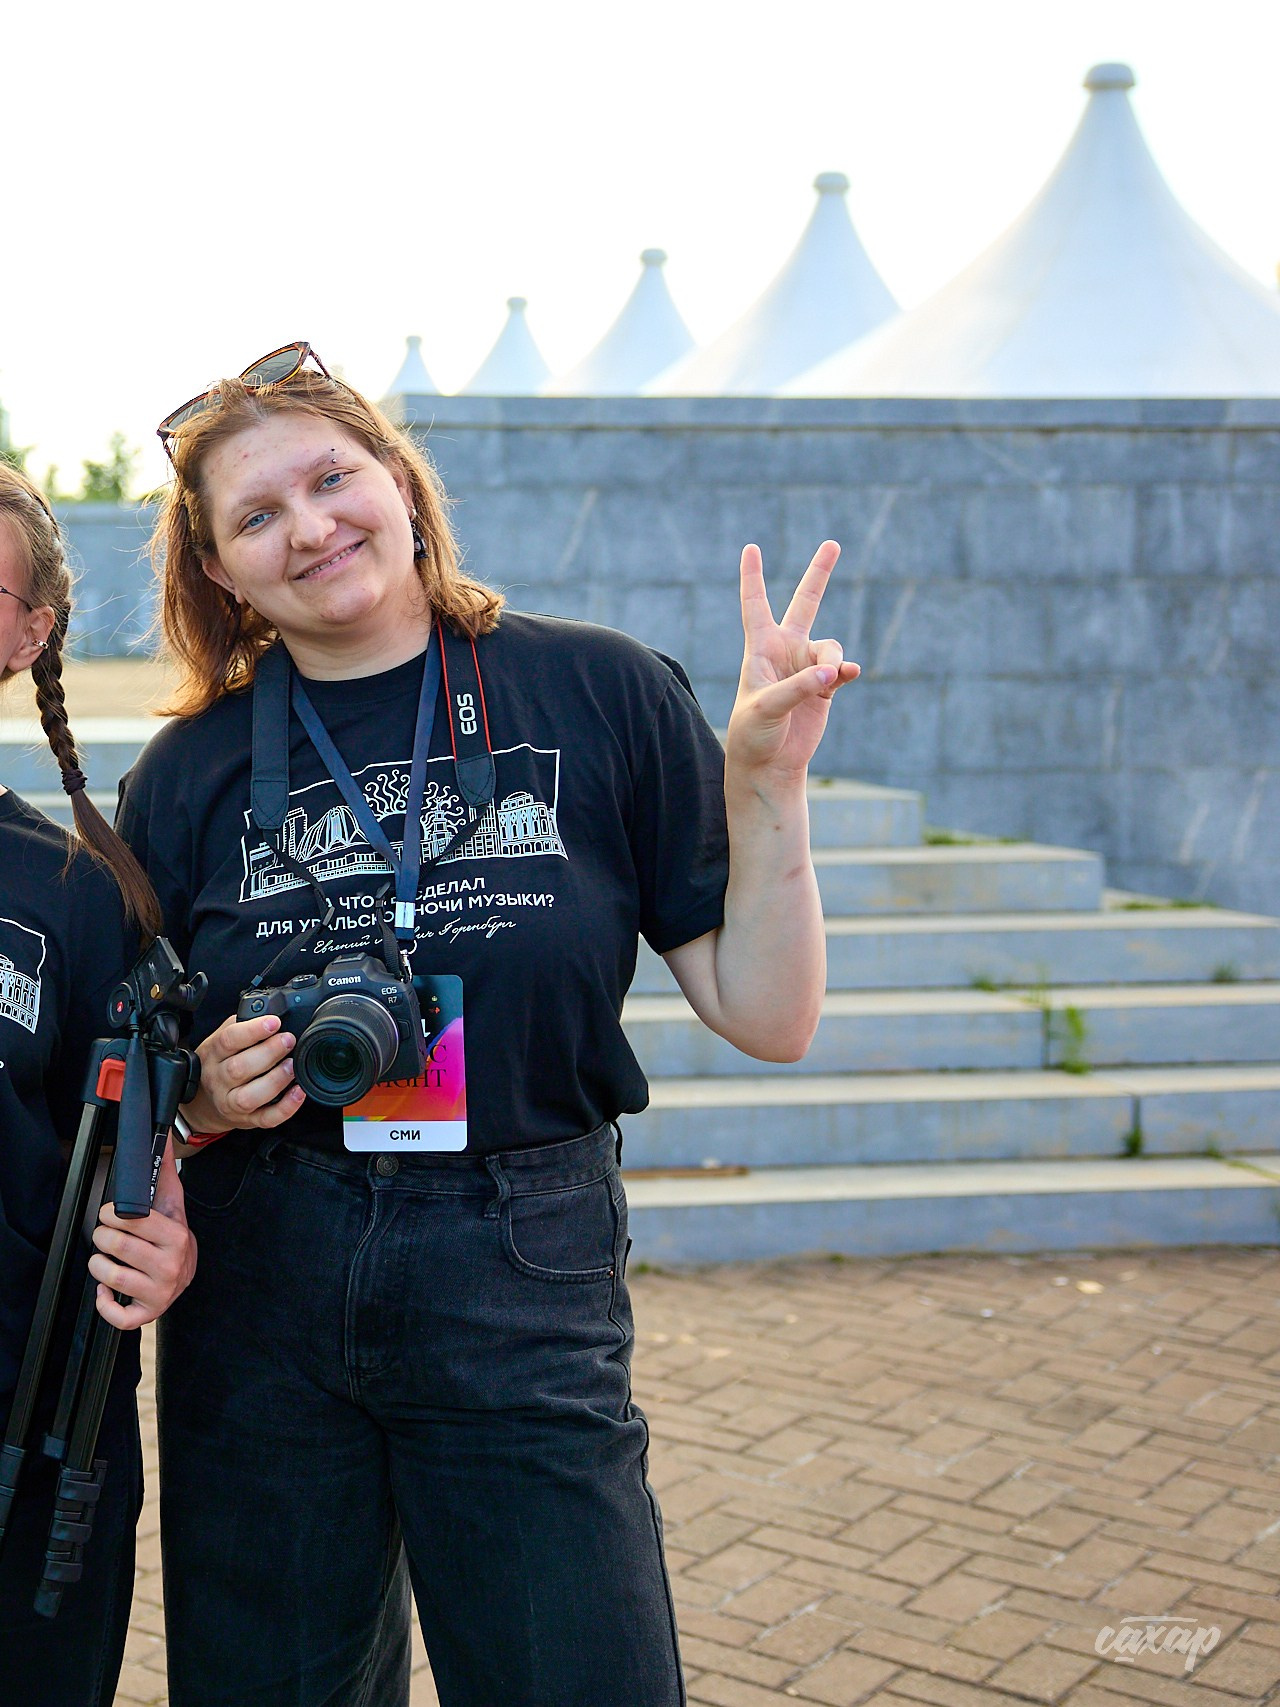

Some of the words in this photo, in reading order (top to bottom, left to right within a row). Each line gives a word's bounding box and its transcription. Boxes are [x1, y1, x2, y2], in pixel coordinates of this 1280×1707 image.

[456, 693, 478, 735] EOS
[339, 895, 375, 910] ЧТО
[255, 919, 294, 939] ДЛЯ
[468, 893, 555, 910] МУЗЫКИ?
[327, 975, 362, 987] Canon
[381, 986, 398, 995] EOS
[387, 996, 398, 1004] R7
[389, 1129, 421, 1141] СМИ
